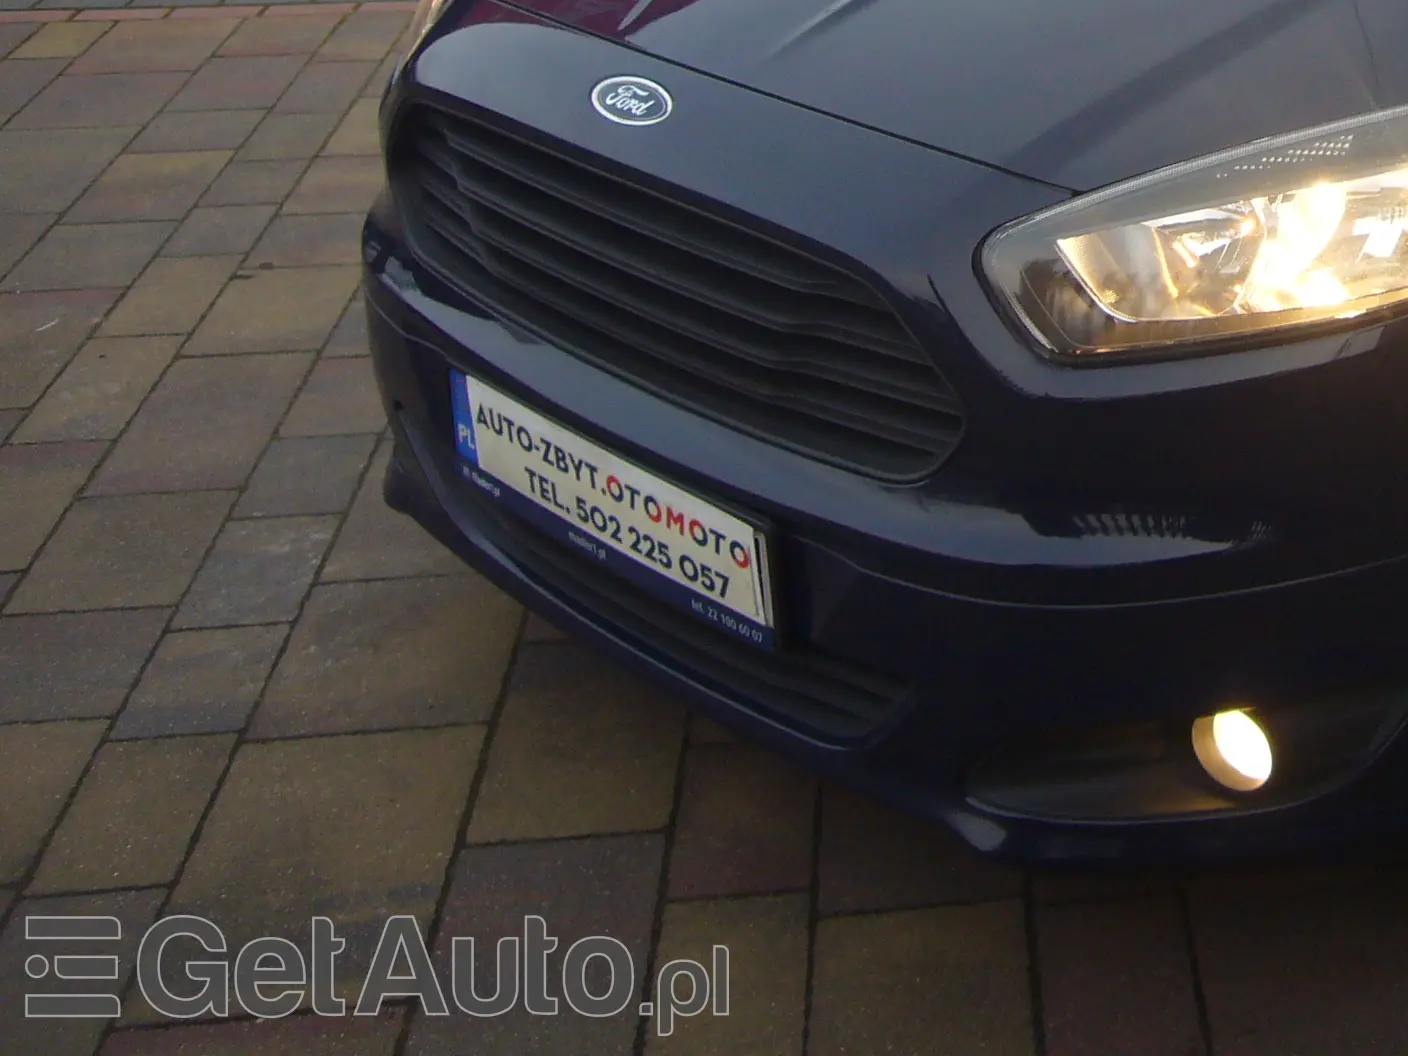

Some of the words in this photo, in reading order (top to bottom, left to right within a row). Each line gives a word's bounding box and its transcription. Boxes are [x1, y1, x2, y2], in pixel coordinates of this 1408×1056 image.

[605, 84, 656, 116] Ford
[457, 423, 475, 450] PL
[524, 466, 571, 515] TEL.
[575, 496, 622, 544] 502
[628, 527, 673, 570] 225
